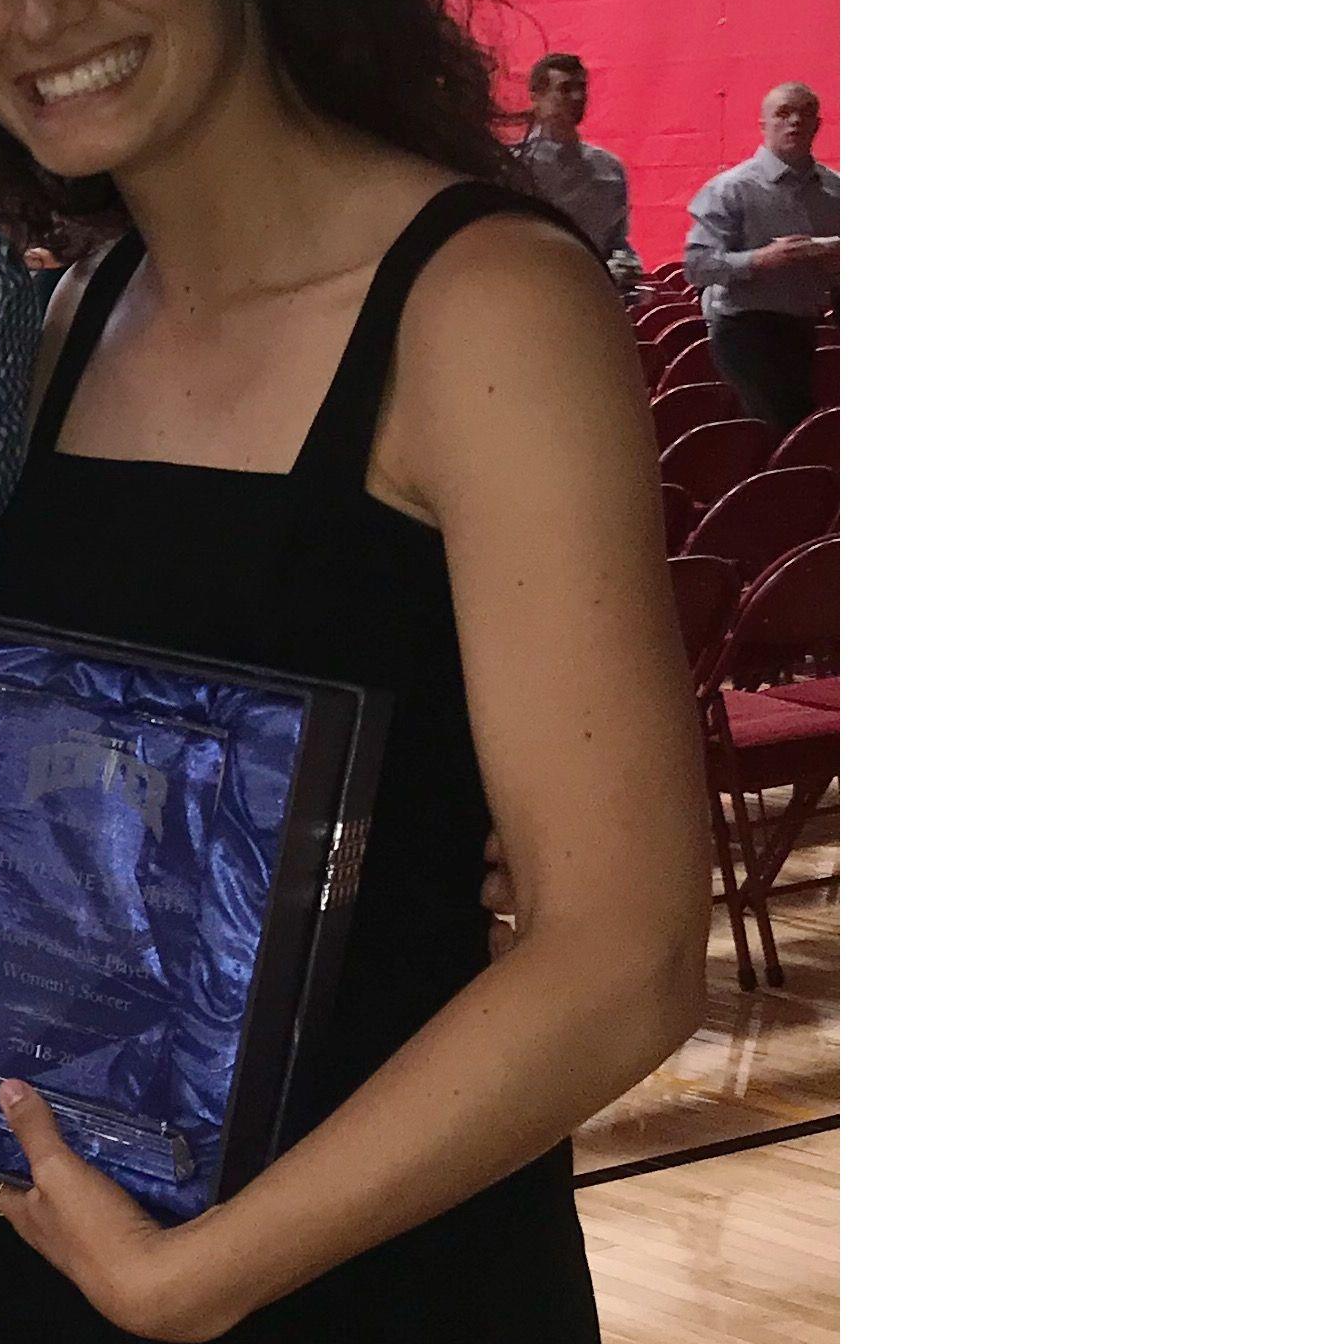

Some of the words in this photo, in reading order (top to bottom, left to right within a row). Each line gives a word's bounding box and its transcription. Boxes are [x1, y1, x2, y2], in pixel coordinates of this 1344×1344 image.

[2, 960, 76, 996] Women's
[79, 983, 133, 1012] Soccer
[16, 1039, 93, 1072] 2018-20
